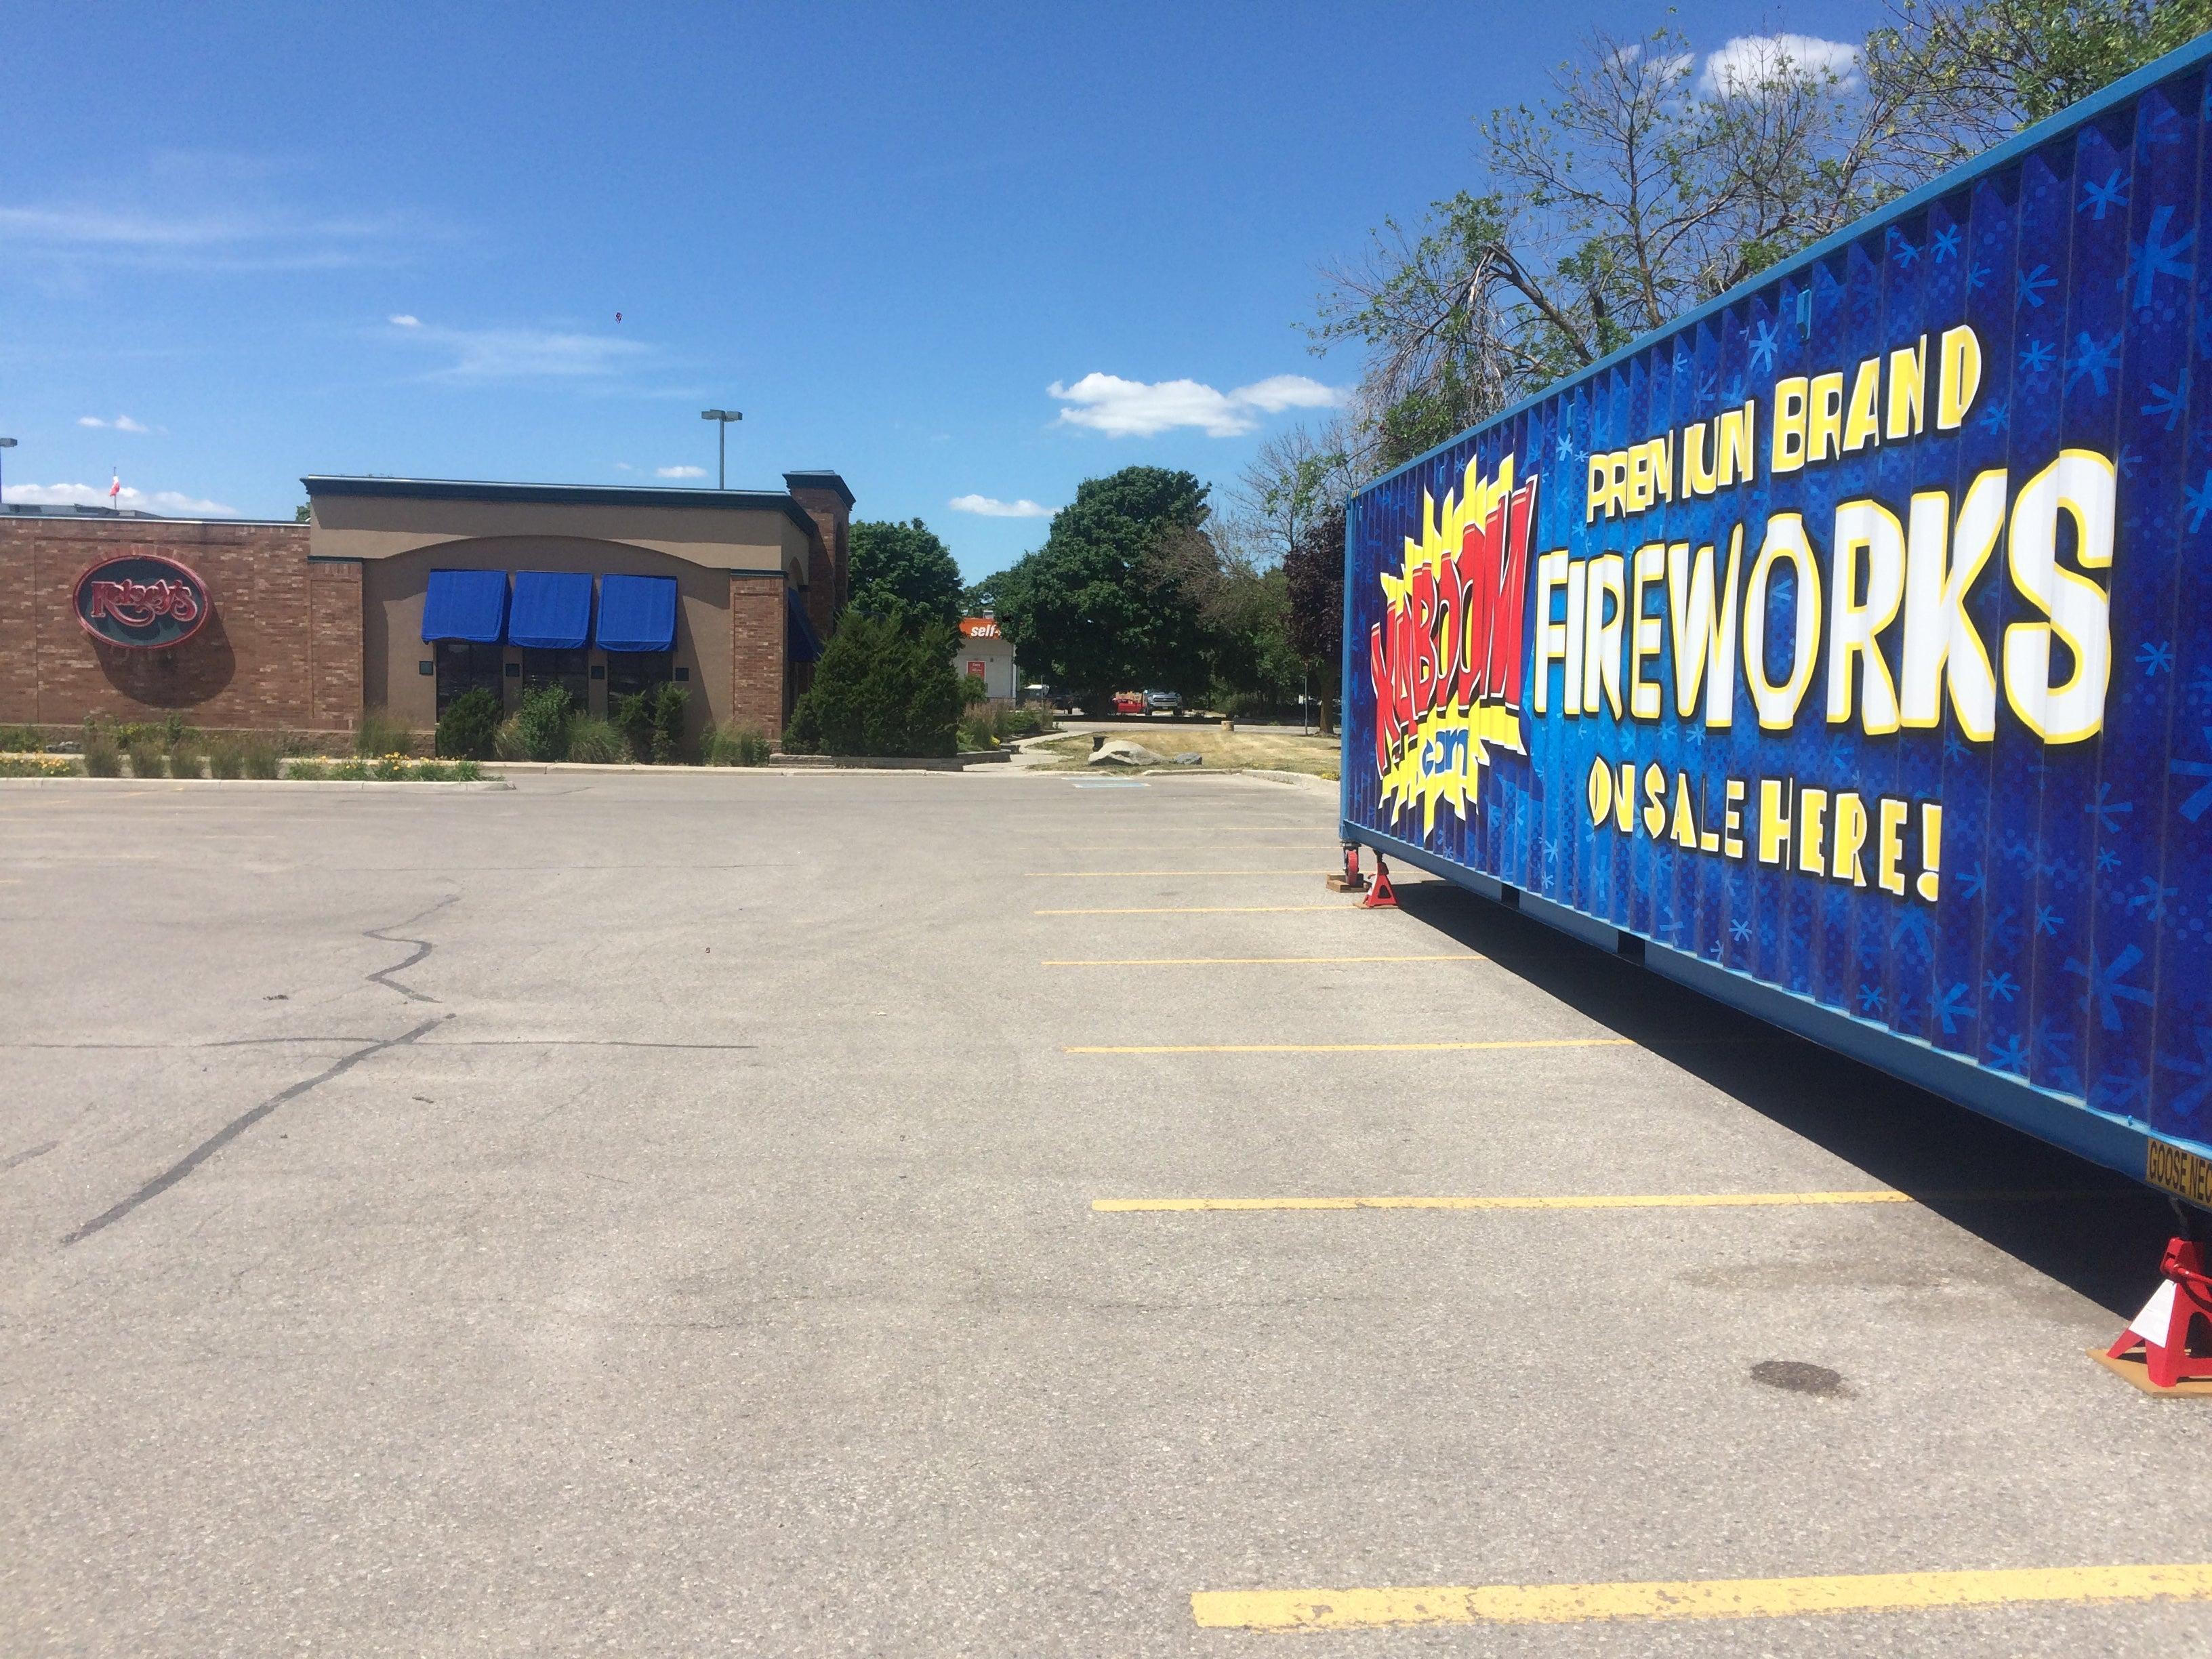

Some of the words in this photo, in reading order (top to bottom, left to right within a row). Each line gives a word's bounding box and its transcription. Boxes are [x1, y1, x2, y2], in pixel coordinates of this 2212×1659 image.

[1771, 324, 1982, 473] BRAND
[1371, 474, 1538, 780] KABOOM
[1534, 449, 2116, 745] FIREWORKS
[1588, 756, 1635, 832] ON
[1643, 763, 1744, 858] SALE
[1759, 778, 1942, 901] HERE!
[2150, 1141, 2187, 1193] GOOSE
